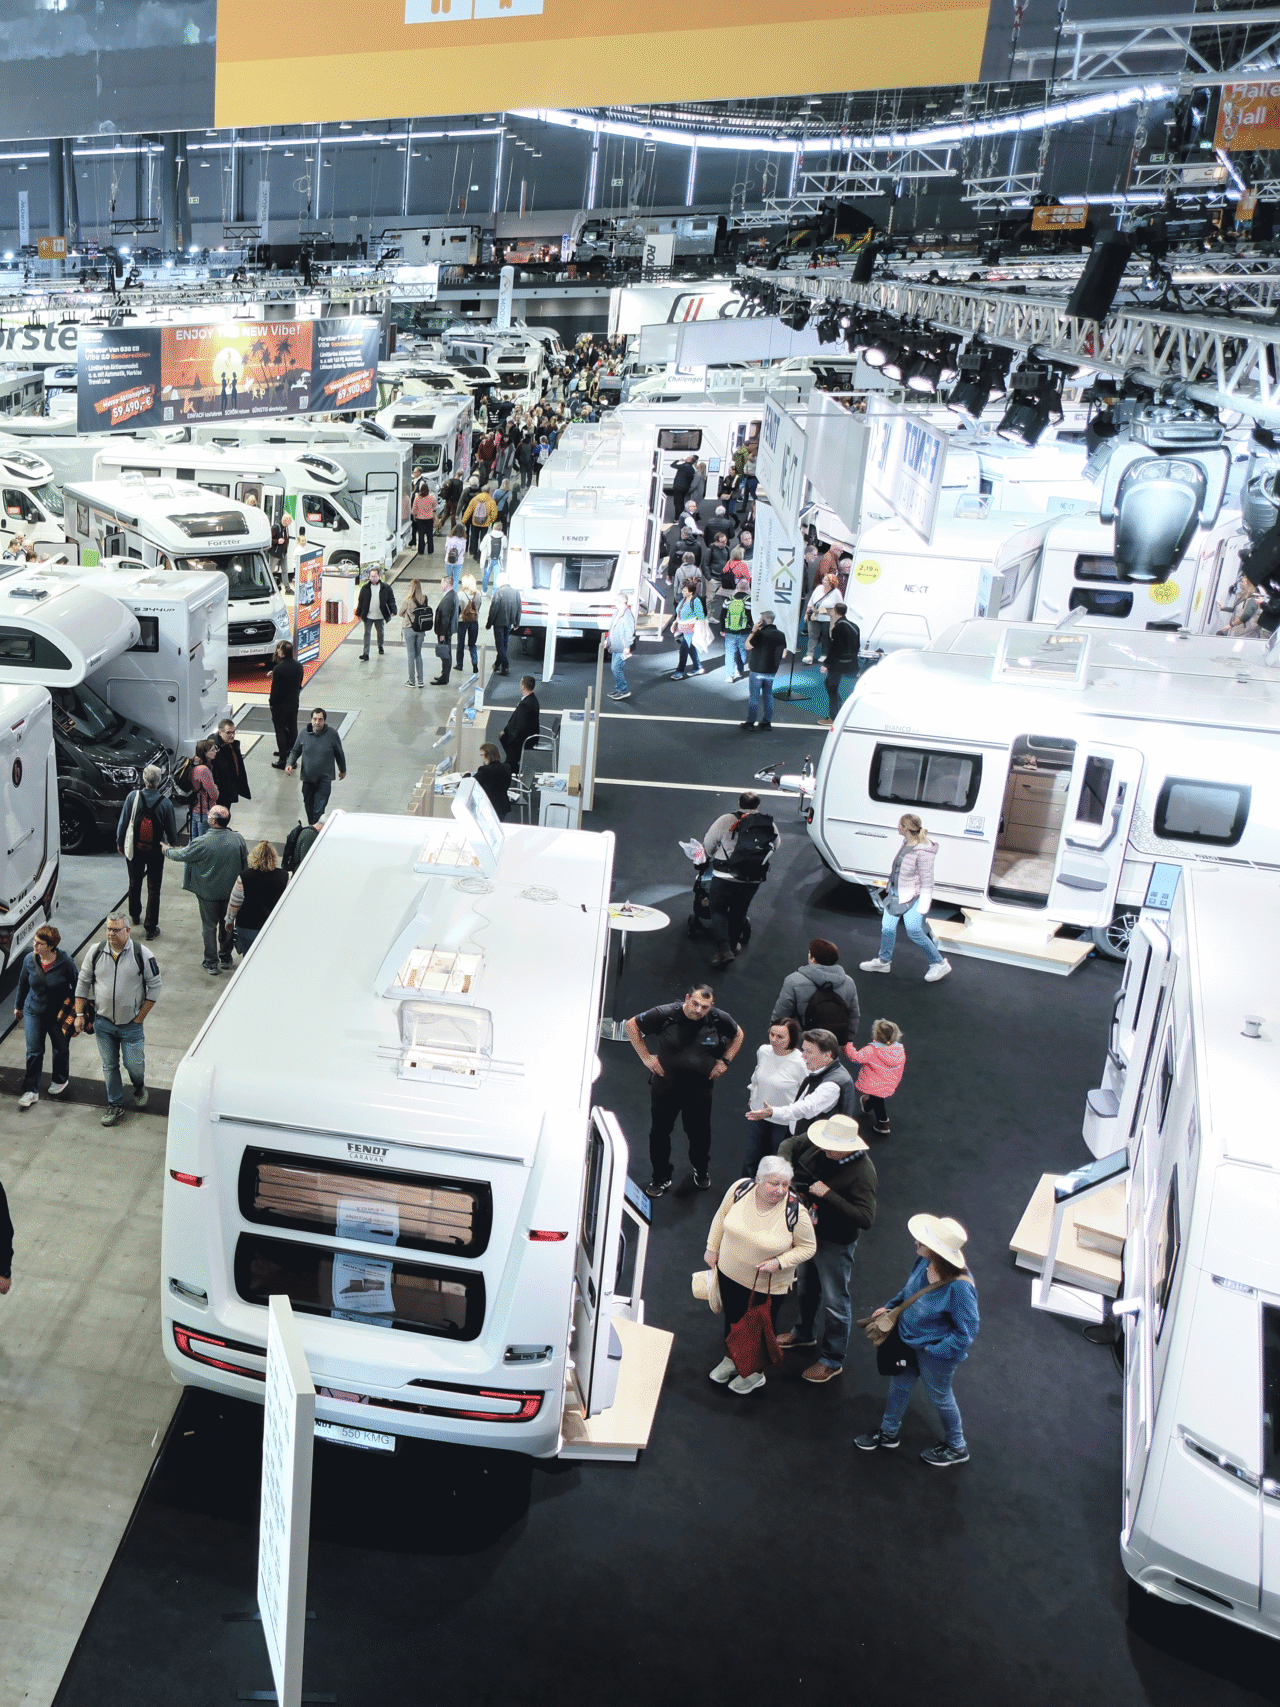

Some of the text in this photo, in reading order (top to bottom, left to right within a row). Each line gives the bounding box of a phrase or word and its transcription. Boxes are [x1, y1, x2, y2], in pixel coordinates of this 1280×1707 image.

[176, 329, 214, 341] ENJOY
[242, 325, 268, 337] NEW
[271, 324, 301, 336] Vibe!
[667, 375, 704, 387] Challenger
[207, 537, 243, 548] Forster
[561, 535, 591, 543] FENDT
[903, 584, 930, 595] NEXT
[18, 895, 37, 915] MILEO
[347, 1142, 390, 1156] FENDT
[349, 1152, 385, 1163] CARAVAN
[341, 1427, 361, 1439] 550
[363, 1431, 391, 1445] KMG
